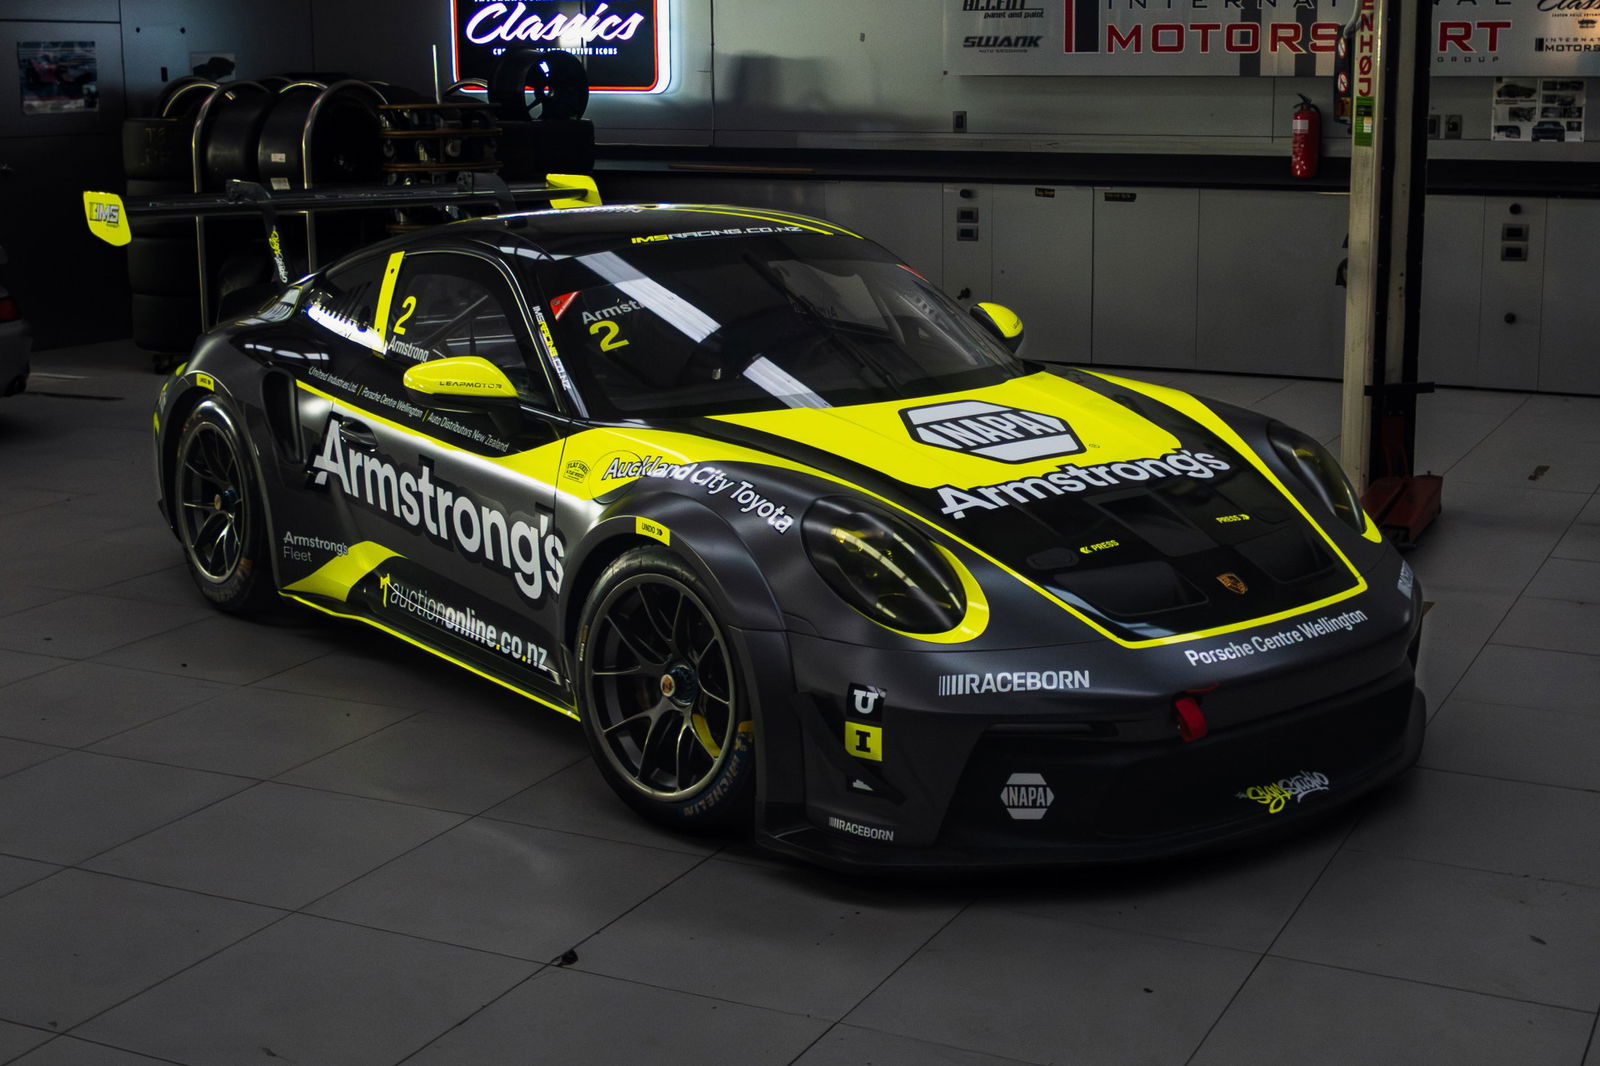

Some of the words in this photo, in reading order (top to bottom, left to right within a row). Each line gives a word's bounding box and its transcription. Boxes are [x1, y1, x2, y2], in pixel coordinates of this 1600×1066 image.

[466, 3, 644, 44] Classics
[984, 11, 1006, 19] panel
[1024, 11, 1044, 19] paint
[963, 35, 1042, 48] SWANK
[1107, 22, 1511, 53] MOTORSRT
[631, 226, 803, 245] IMSRACING.CO.NZ
[393, 295, 417, 336] 2
[589, 320, 631, 353] 2
[439, 381, 502, 389] LEAPMOTOR
[308, 365, 328, 381] United
[361, 386, 382, 402] Porsche
[380, 393, 397, 409] Centre
[396, 400, 425, 419] Wellington
[428, 411, 442, 426] Auto
[440, 416, 473, 439] Distributors
[472, 428, 486, 443] New
[484, 434, 511, 453] Zealand
[937, 410, 1050, 447] NAPA
[601, 455, 693, 481] Auckland
[690, 462, 736, 494] City
[730, 481, 795, 535] Toyota
[940, 450, 1231, 519] Armstrong's
[313, 418, 565, 600] Armstrong's
[283, 530, 349, 556] Armstrong's
[283, 545, 313, 563] Fleet
[1091, 539, 1120, 553] PRESS
[389, 582, 549, 673] auctiononline.co.nz
[1184, 642, 1254, 667] Porsche
[1250, 627, 1303, 653] Centre
[1300, 607, 1369, 641] Wellington
[964, 670, 1090, 694] RACEBORN
[1007, 786, 1049, 807] NAPA
[839, 820, 895, 842] RACEBORN
